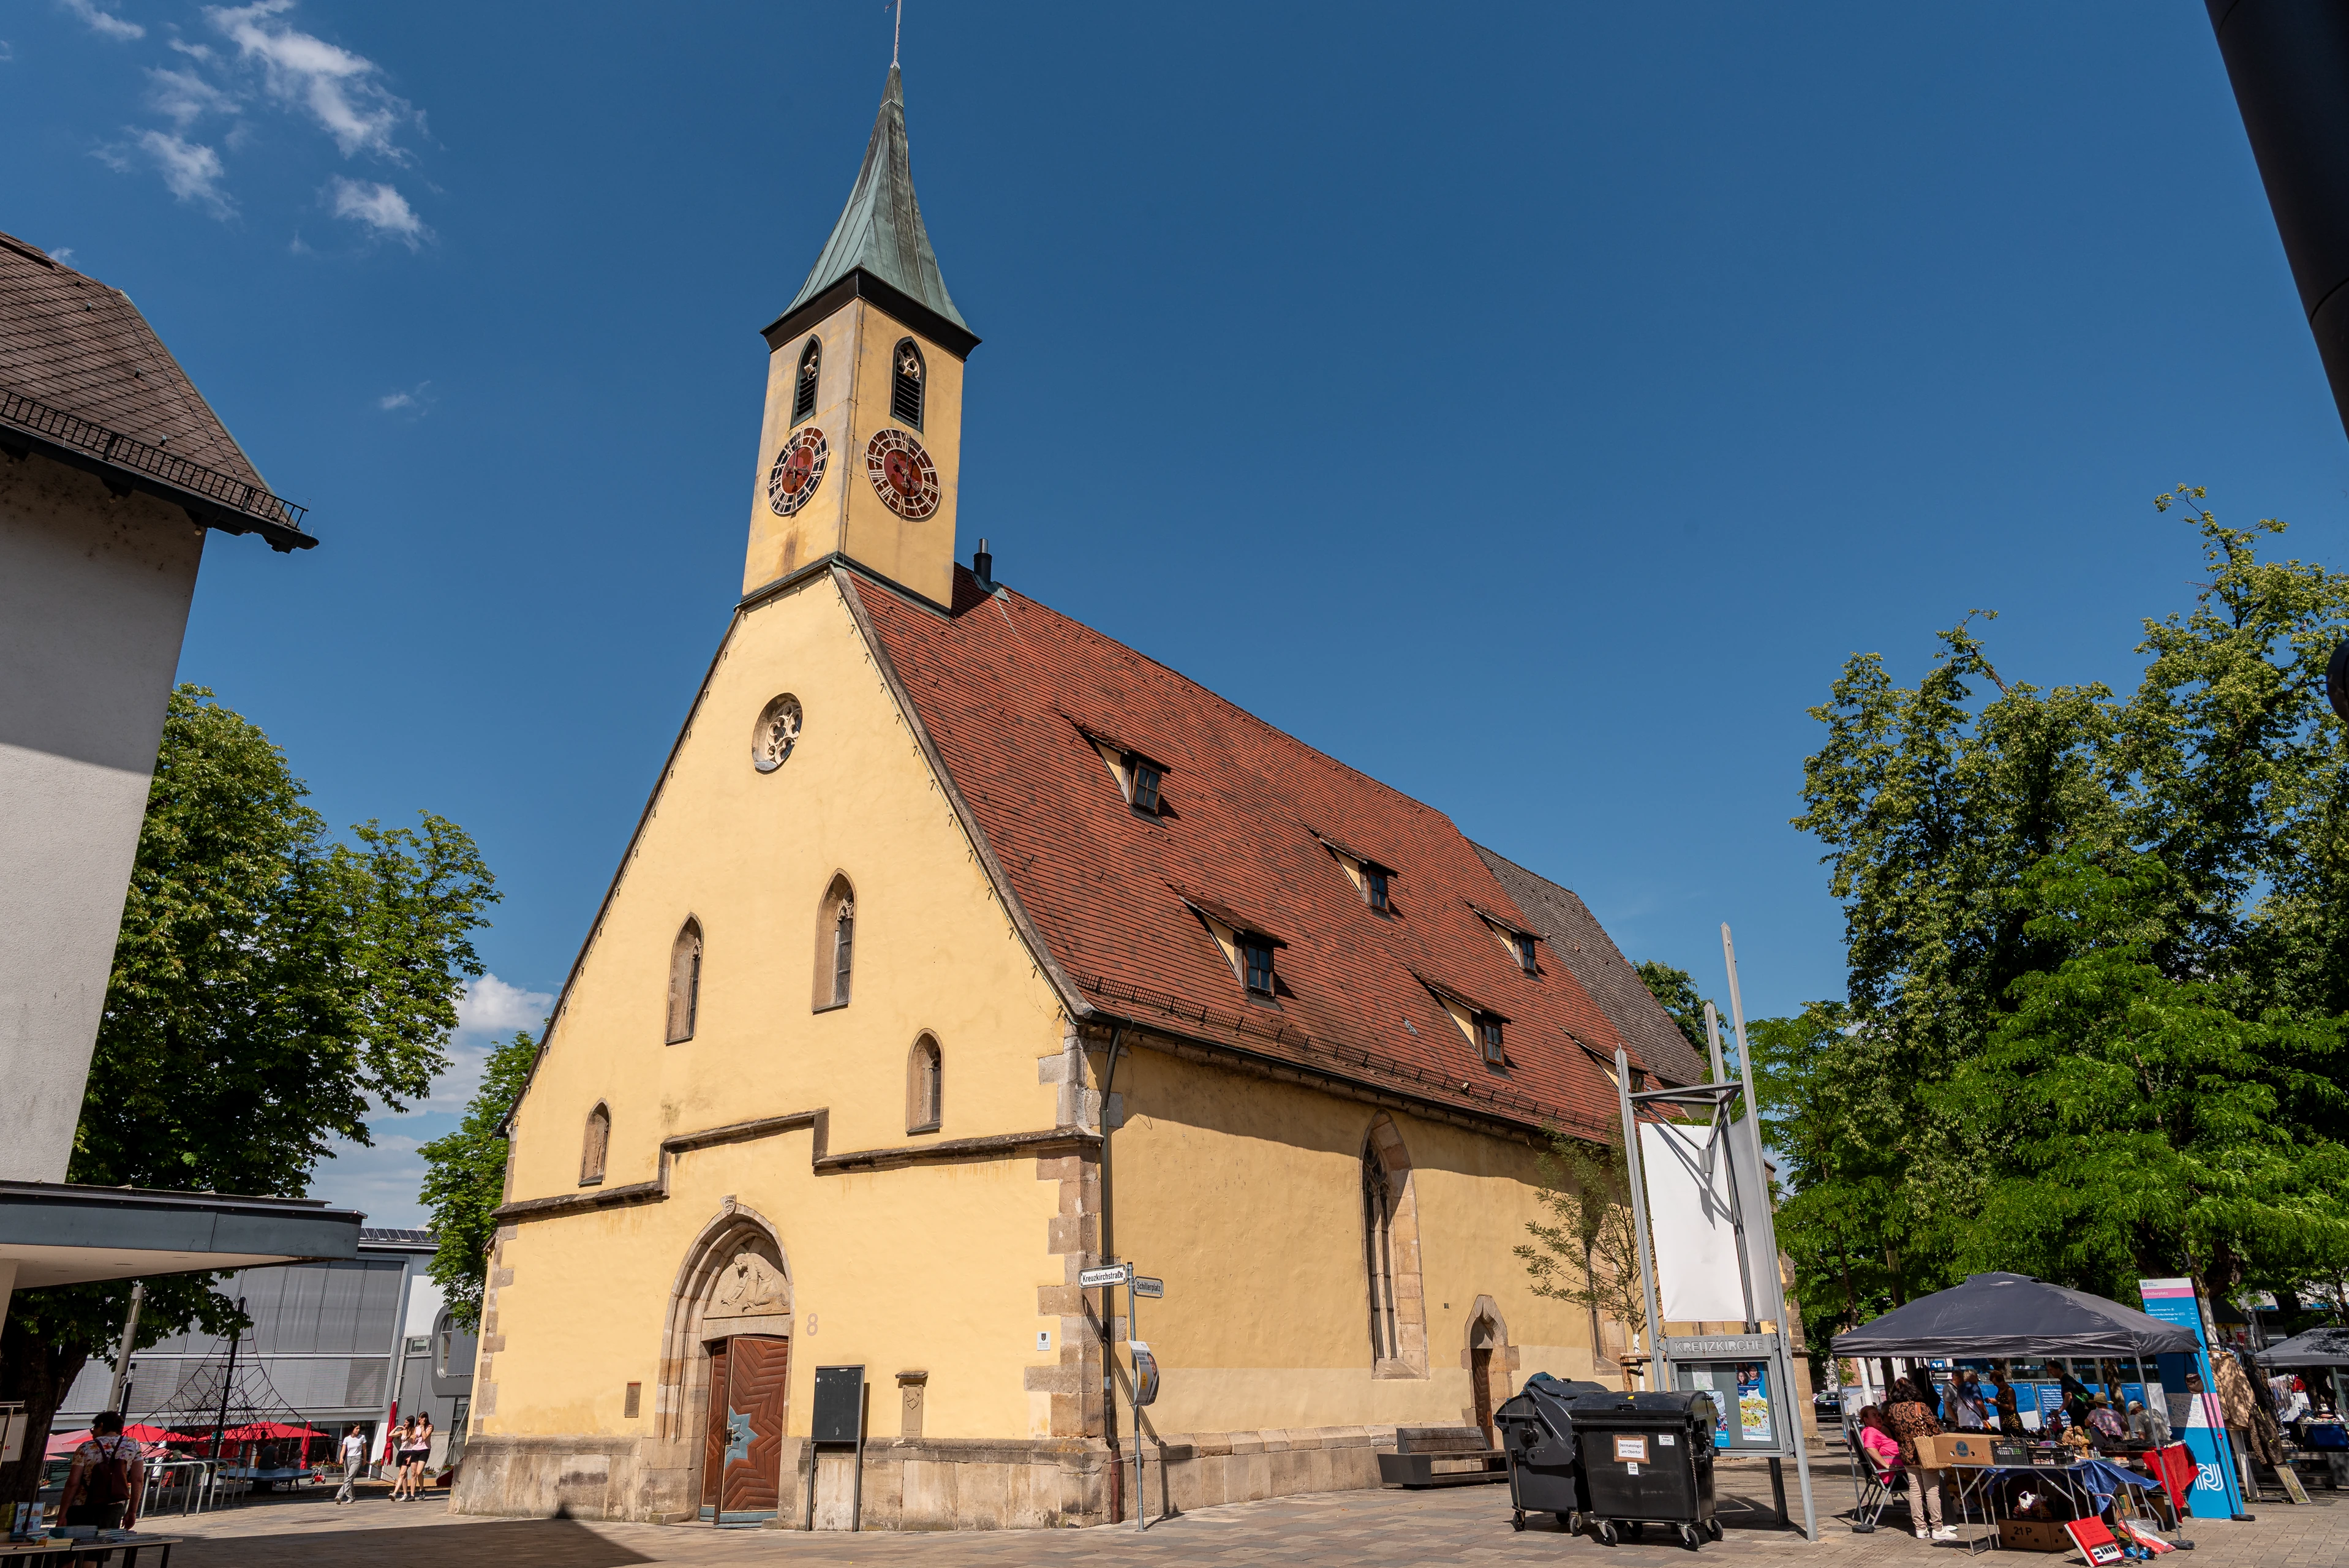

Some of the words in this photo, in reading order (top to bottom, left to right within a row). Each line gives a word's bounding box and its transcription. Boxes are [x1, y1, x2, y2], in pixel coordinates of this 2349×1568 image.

[1082, 1270, 1123, 1283] Kreuzkirchstraße
[1137, 1282, 1161, 1292] Schillerplatz
[806, 1313, 818, 1336] 8
[1674, 1340, 1764, 1352] KREUZKIRCHE
[2013, 1526, 2023, 1536] 21
[2026, 1527, 2032, 1536] P
